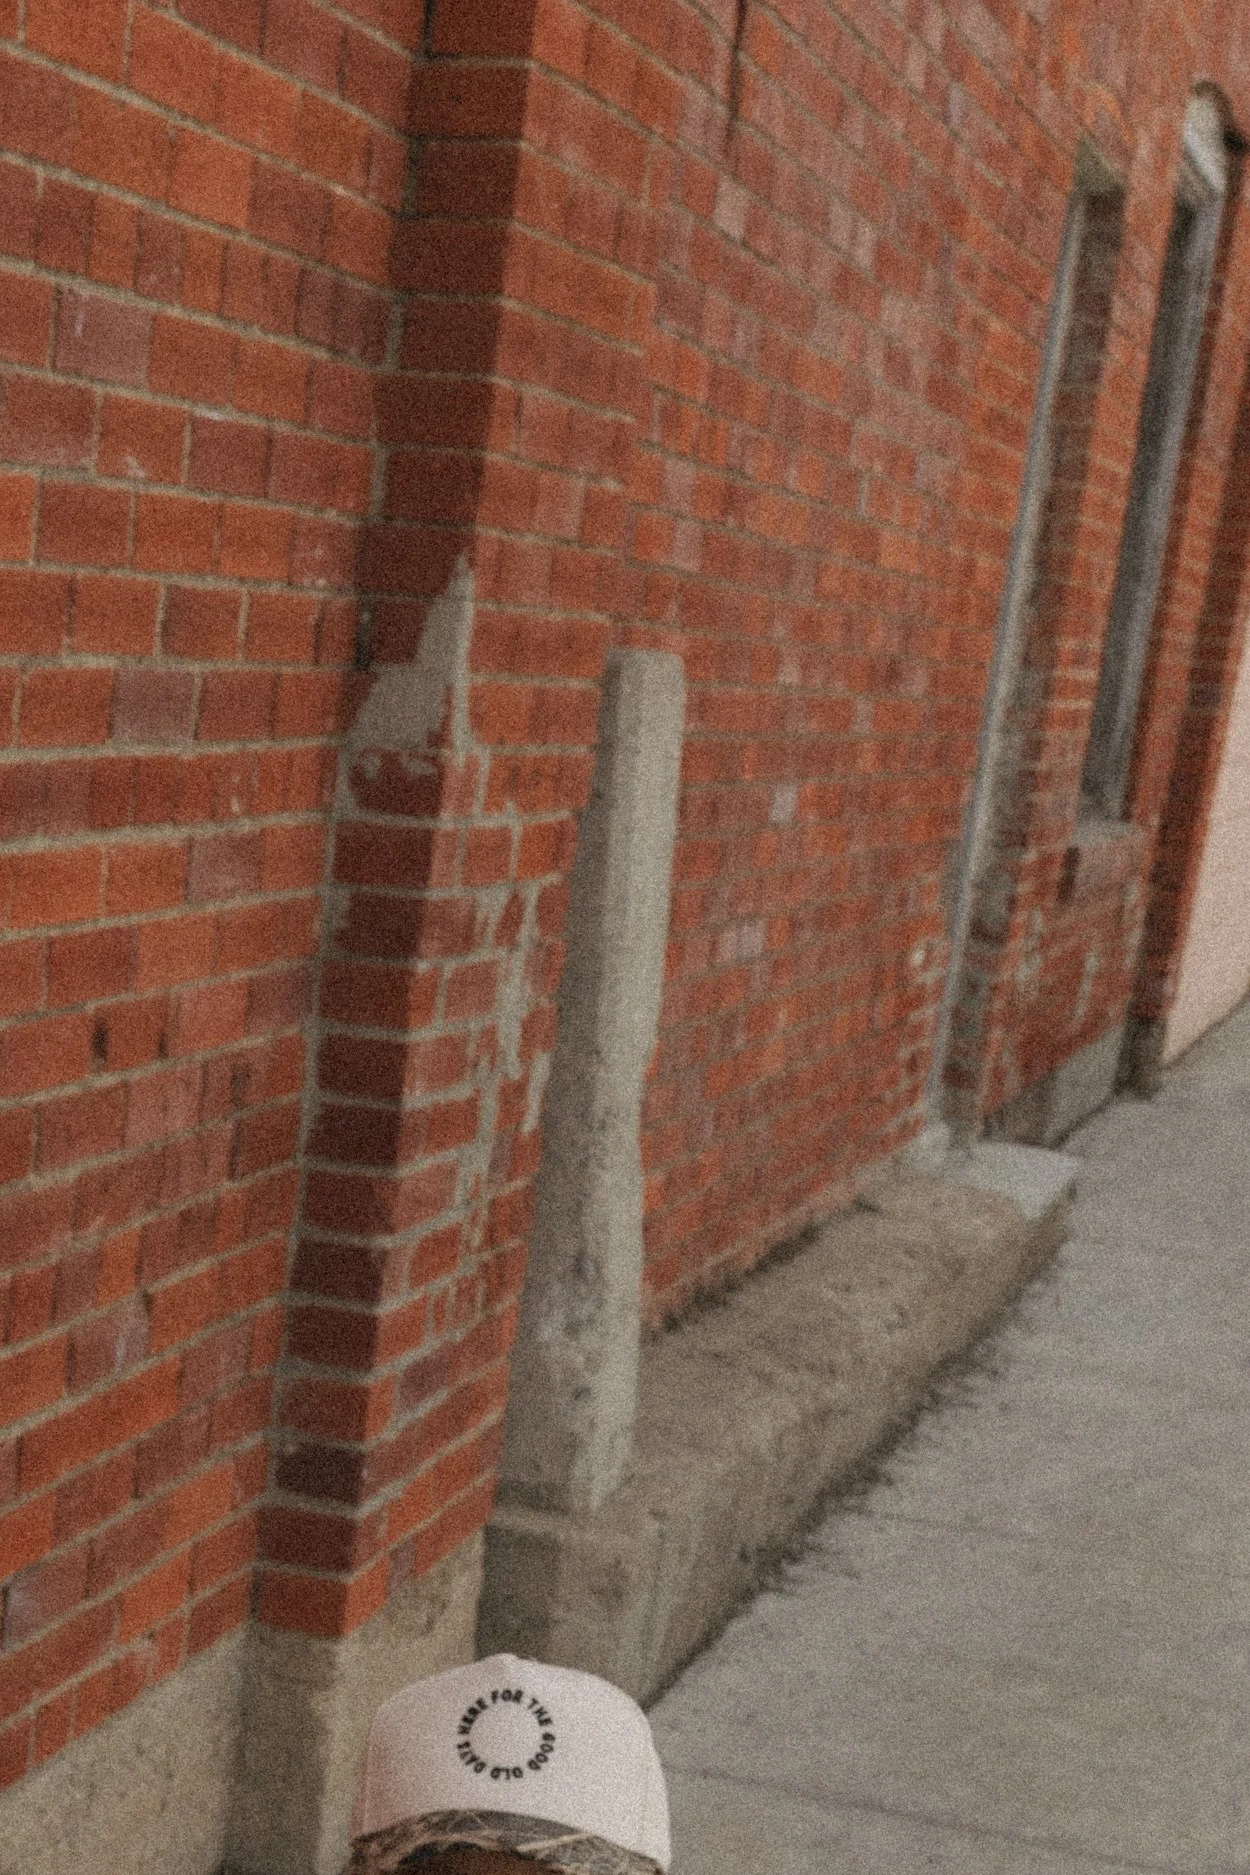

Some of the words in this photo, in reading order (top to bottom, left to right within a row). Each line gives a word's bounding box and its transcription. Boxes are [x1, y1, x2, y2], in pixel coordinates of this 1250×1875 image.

[491, 1689, 523, 1704] FOR
[527, 1698, 552, 1726] THE
[528, 1733, 555, 1770] GOOD
[490, 1767, 523, 1779] OLD
